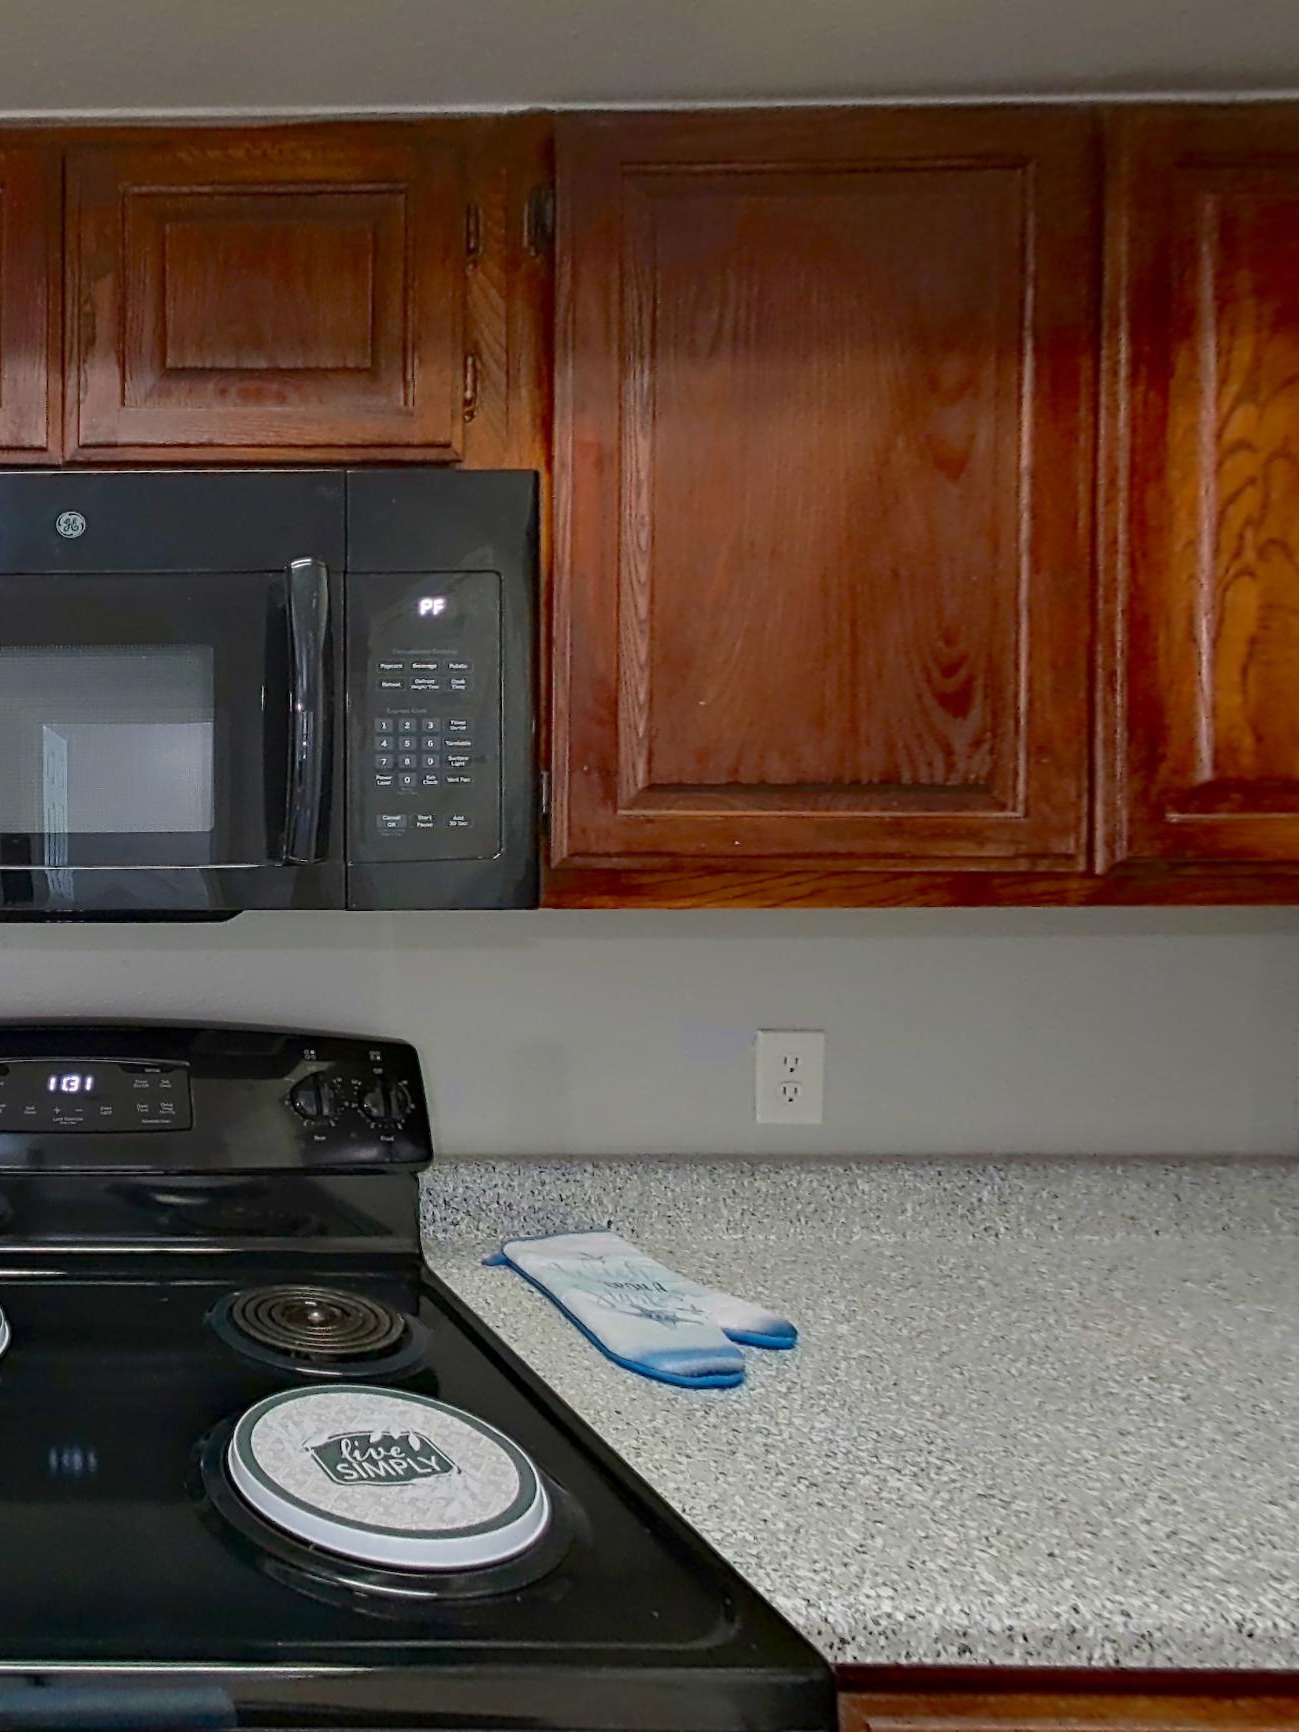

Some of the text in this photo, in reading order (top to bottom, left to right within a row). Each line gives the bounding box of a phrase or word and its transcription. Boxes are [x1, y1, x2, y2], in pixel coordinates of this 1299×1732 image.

[420, 599, 445, 615] PF
[404, 721, 411, 729] 2
[427, 721, 434, 729] 3
[381, 739, 388, 747] 4
[404, 739, 411, 747] 5
[427, 739, 434, 747] 6
[404, 757, 411, 765] 8
[427, 757, 434, 765] 9
[404, 776, 411, 784] 0
[341, 1438, 405, 1463] live
[337, 1456, 440, 1479] SIMPLY
